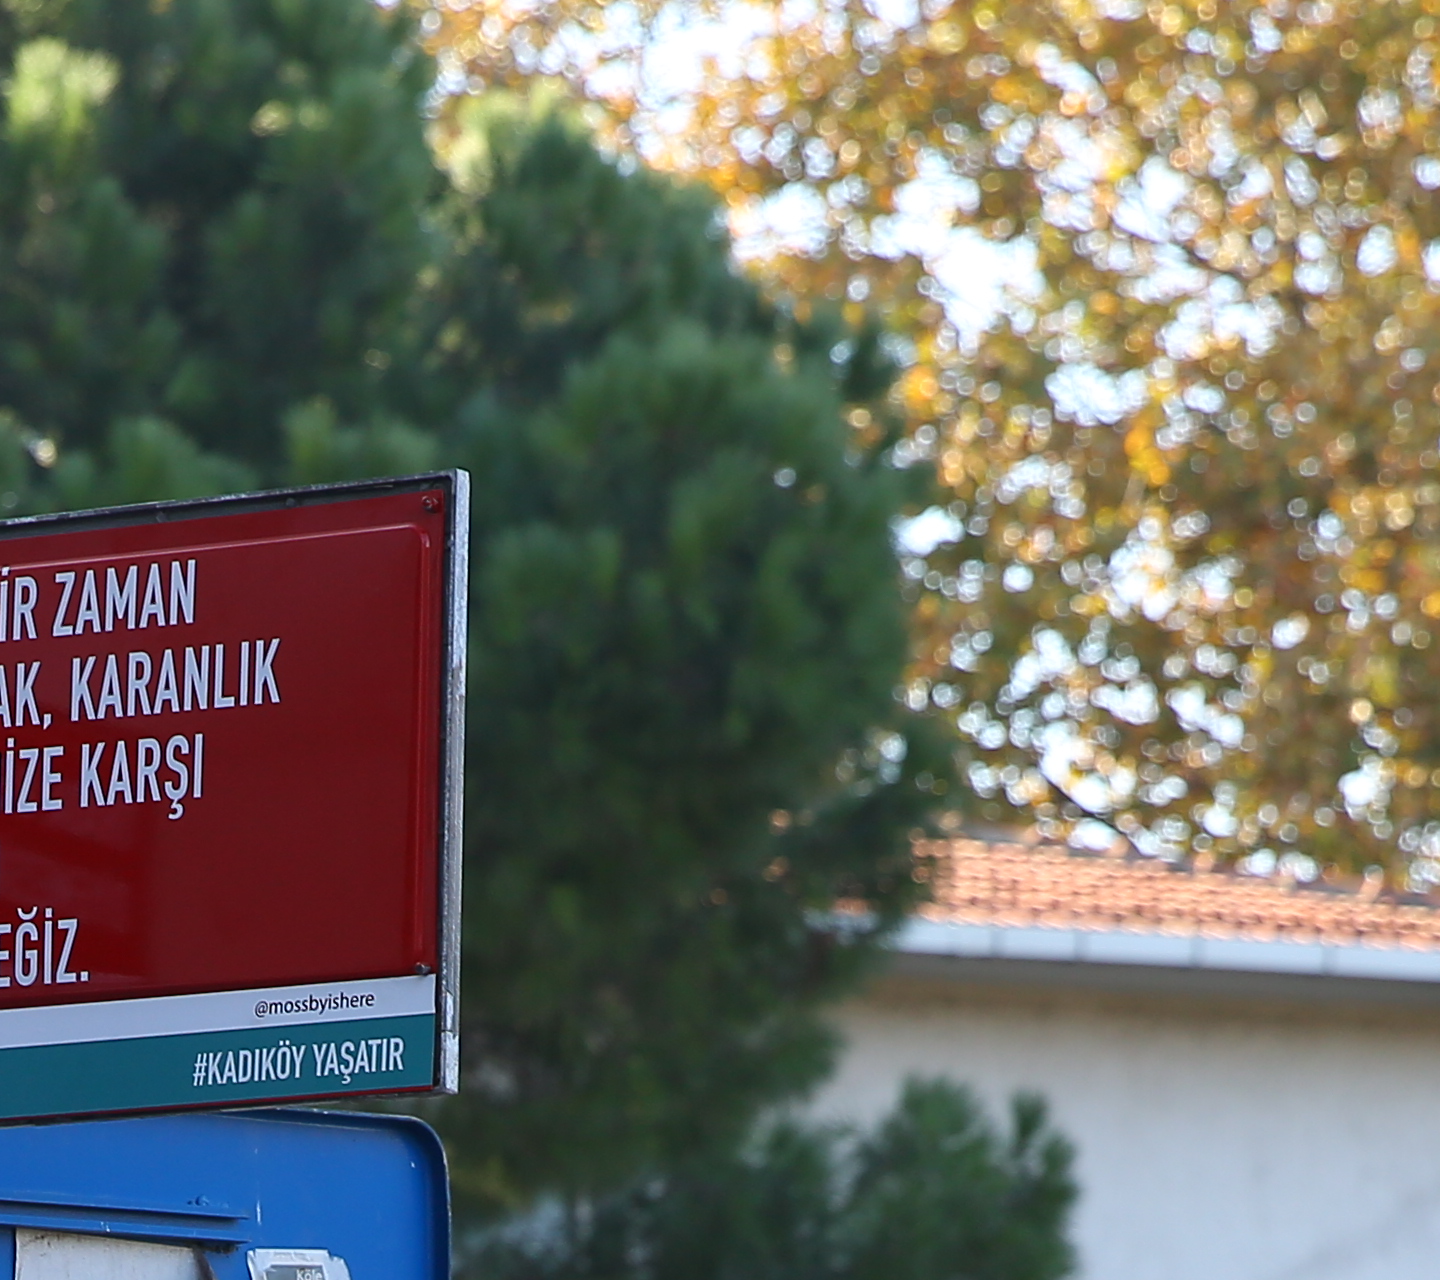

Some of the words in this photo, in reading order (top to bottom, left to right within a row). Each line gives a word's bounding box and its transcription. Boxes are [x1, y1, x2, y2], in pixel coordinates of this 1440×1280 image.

[53, 559, 196, 638] ZAMAN
[71, 637, 281, 722] KARANLIK
[80, 732, 204, 820] KARŞI
[255, 991, 375, 1018] @mossbyishere
[193, 1040, 306, 1087] #KADIKÖY
[312, 1037, 404, 1085] YAŞATIR
